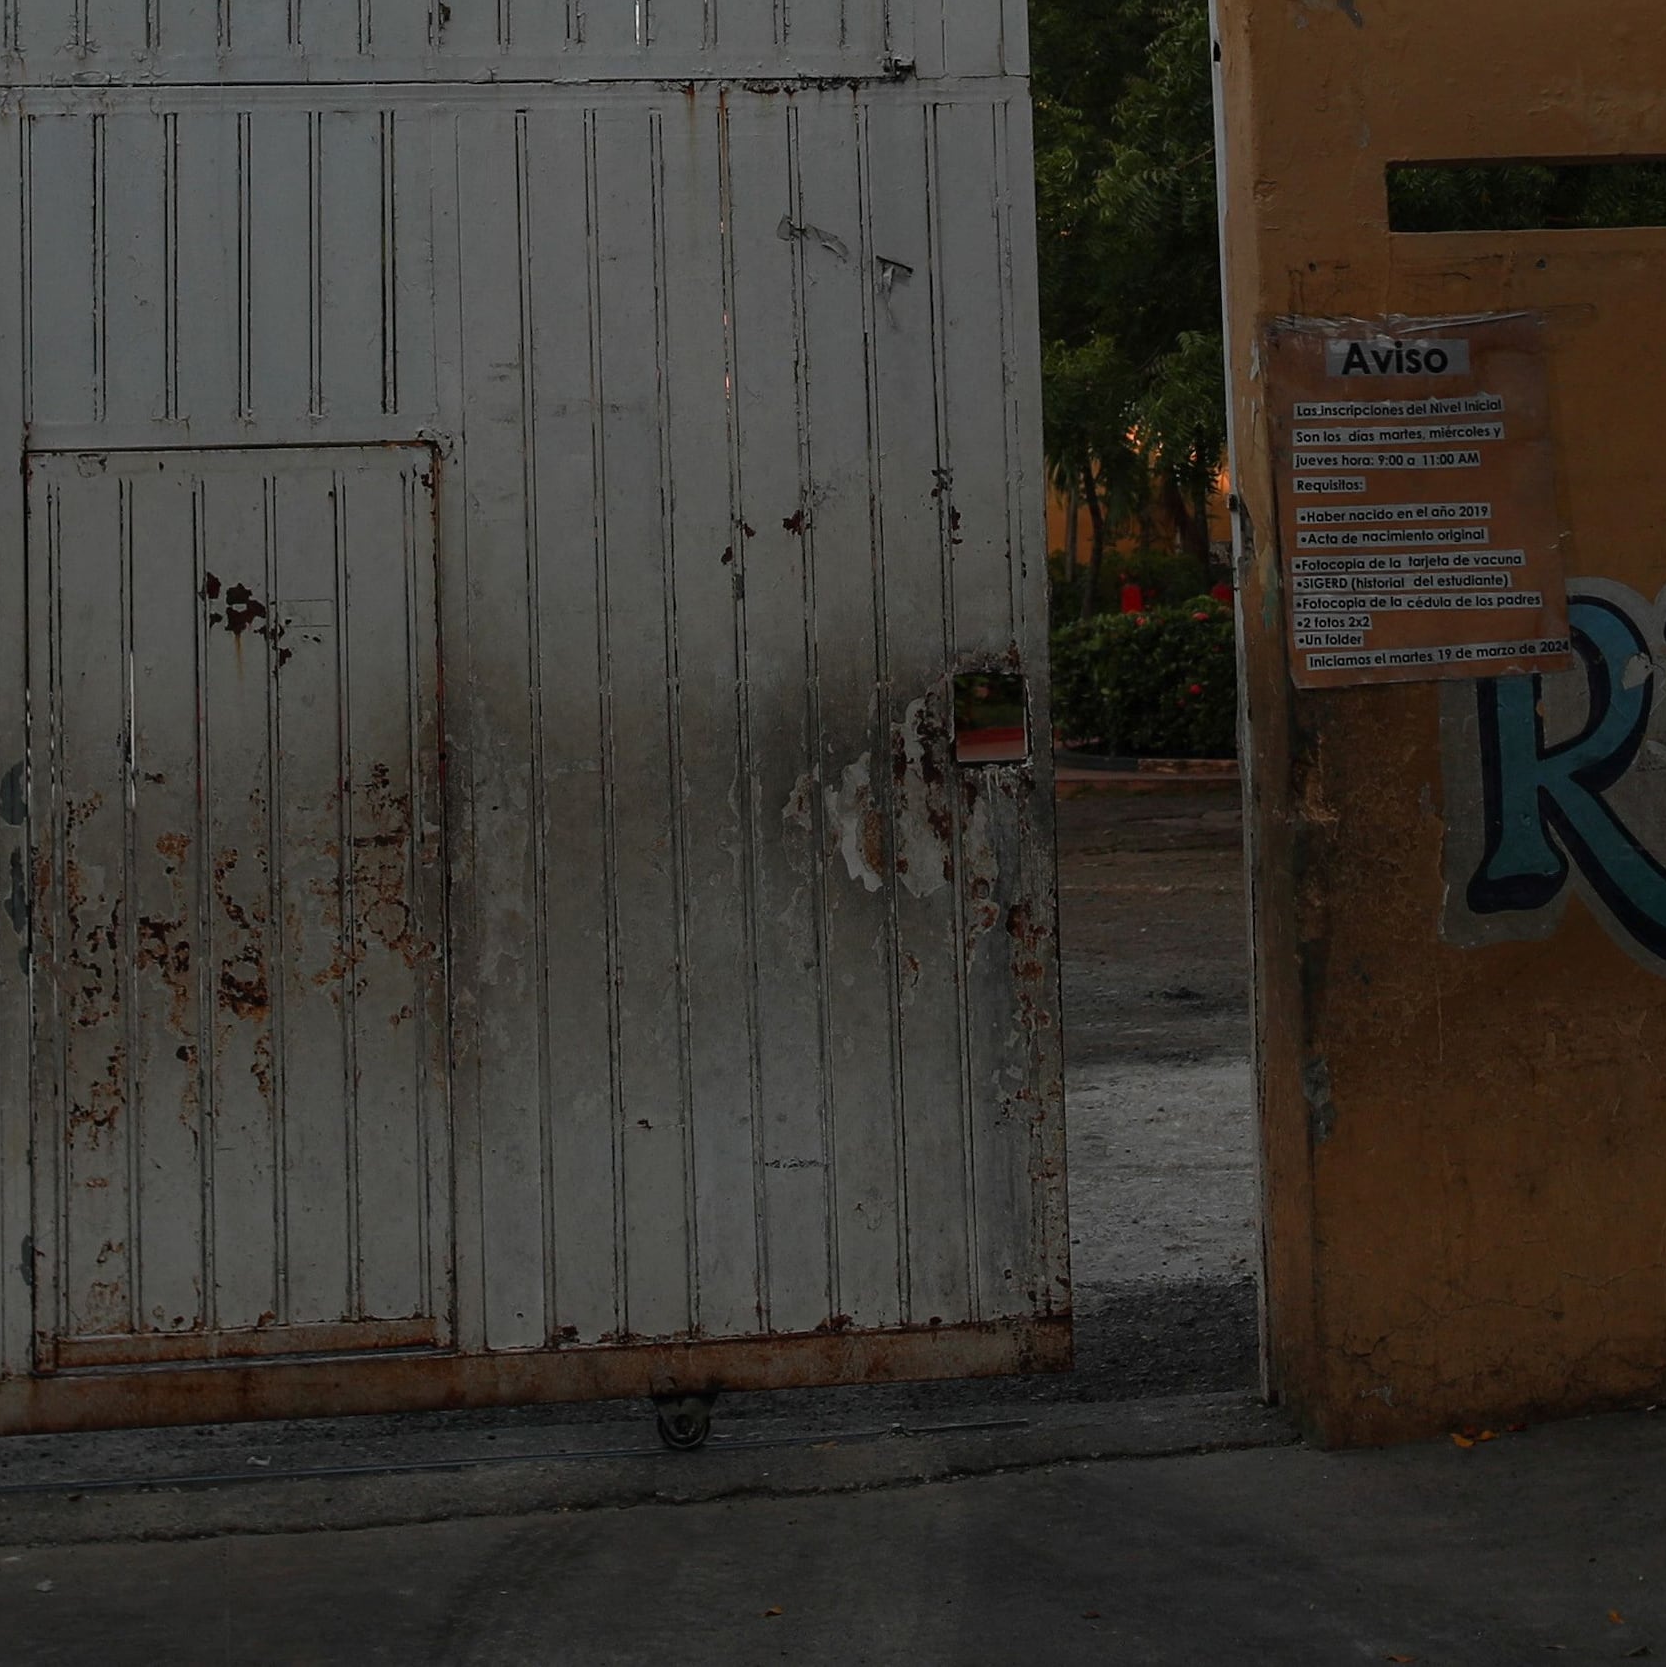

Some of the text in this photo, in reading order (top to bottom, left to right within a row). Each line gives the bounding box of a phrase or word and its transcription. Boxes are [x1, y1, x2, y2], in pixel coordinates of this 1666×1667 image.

[1341, 342, 1449, 375] Aviso
[1321, 405, 1404, 418] inscripciones
[1407, 403, 1425, 415] del
[1430, 399, 1461, 414] Nivel
[1465, 399, 1501, 411] Inicial
[1297, 426, 1501, 442] Son los días martes, miércoles y
[1295, 452, 1479, 468] jueves hora: 9:00 a 11:00 AM
[1297, 480, 1364, 493] Requisitos:
[1349, 509, 1394, 521] nacido
[1397, 510, 1413, 519] en
[1416, 507, 1428, 517] el
[1431, 506, 1456, 517] año
[1459, 506, 1489, 517] 2019
